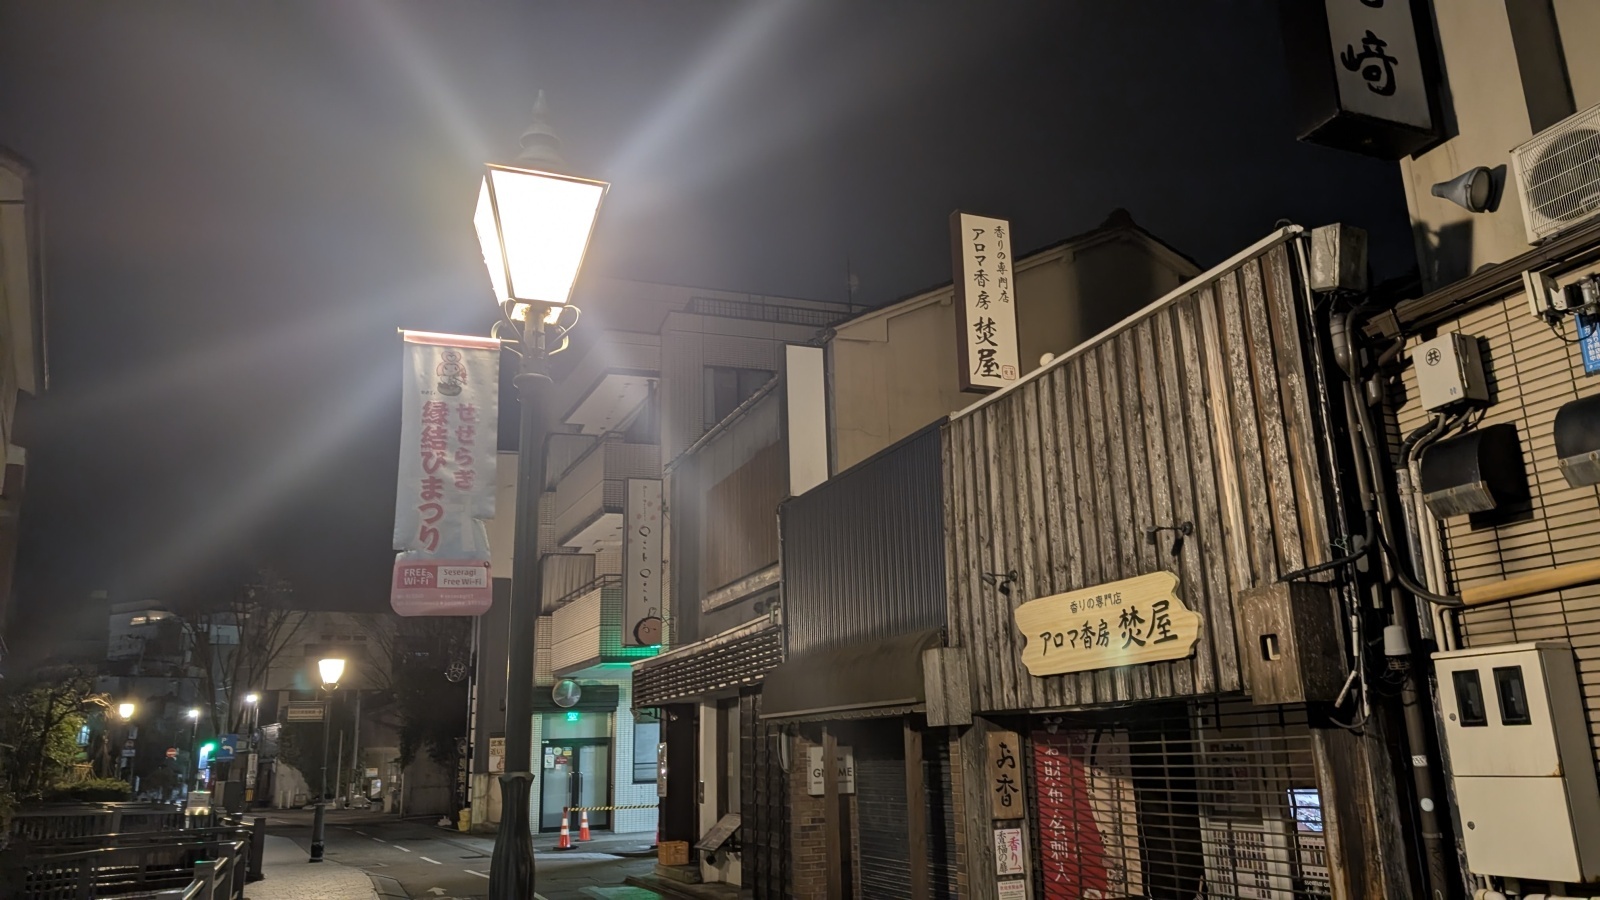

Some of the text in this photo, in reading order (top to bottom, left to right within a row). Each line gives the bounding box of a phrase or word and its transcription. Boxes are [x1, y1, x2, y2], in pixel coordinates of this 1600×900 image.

[993, 225, 1010, 304] 香りの専門店
[973, 316, 1002, 379] 焚屋
[453, 402, 477, 491] せせらぎ
[417, 400, 450, 553] 縁結びまつり
[404, 568, 427, 577] FREE
[404, 577, 429, 586] Wi-Fi
[443, 569, 477, 577] Seseragi
[443, 578, 482, 586] Free Wi-Fi
[1069, 591, 1123, 614] 香りの専門店
[1117, 599, 1179, 650] 焚屋
[995, 741, 1020, 808] お香
[1007, 836, 1021, 866] 香り
